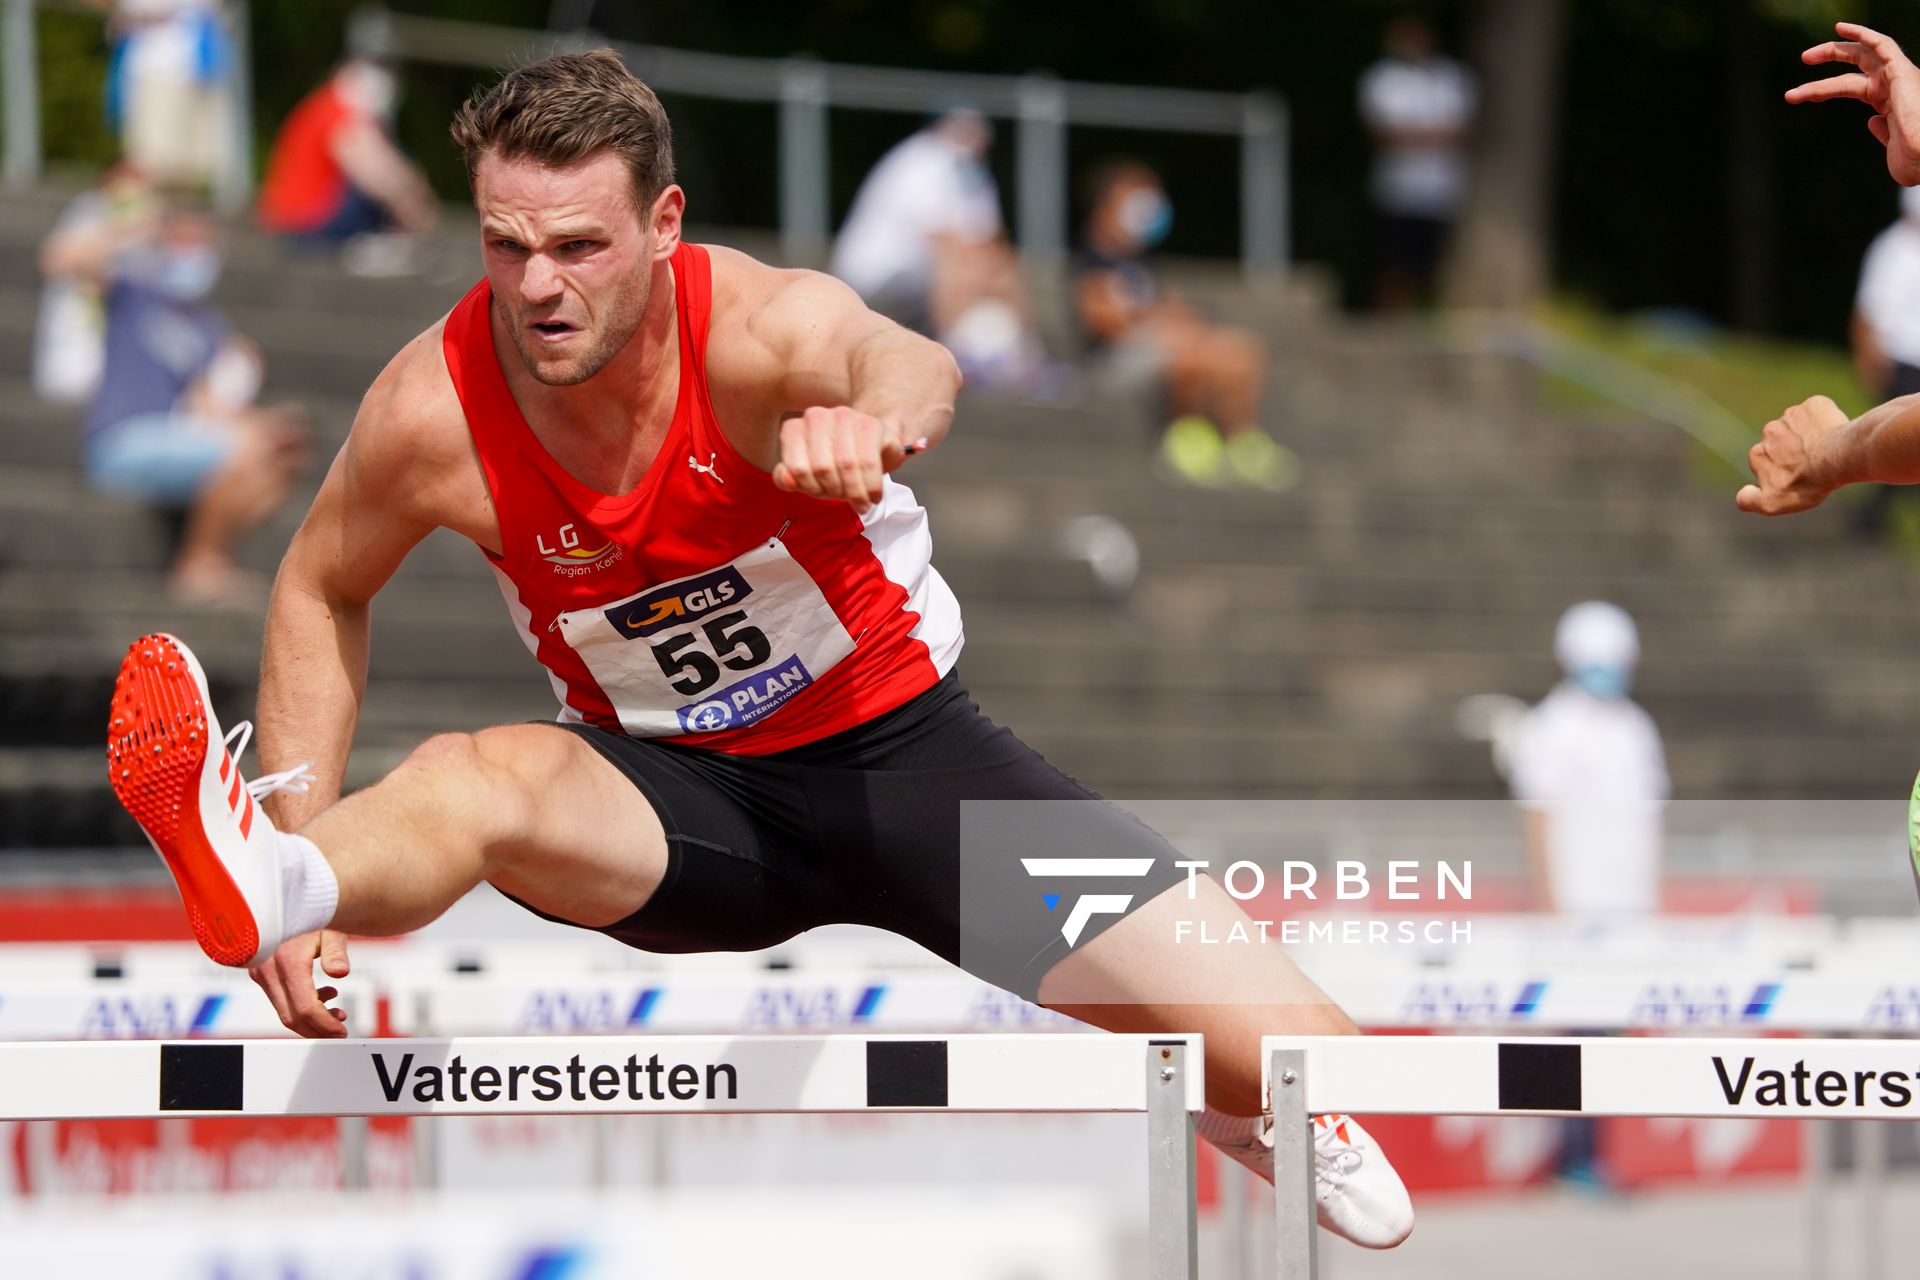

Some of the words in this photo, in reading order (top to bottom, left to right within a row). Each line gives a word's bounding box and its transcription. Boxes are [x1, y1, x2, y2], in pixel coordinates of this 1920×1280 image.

[553, 564, 591, 578] Region
[684, 580, 736, 612] GLS
[650, 609, 771, 696] 55
[731, 665, 804, 712] PLAN
[742, 682, 808, 721] INTERNATIONAL
[371, 1053, 738, 1102] Vaterstetten
[1711, 1056, 1920, 1107] Vaters
